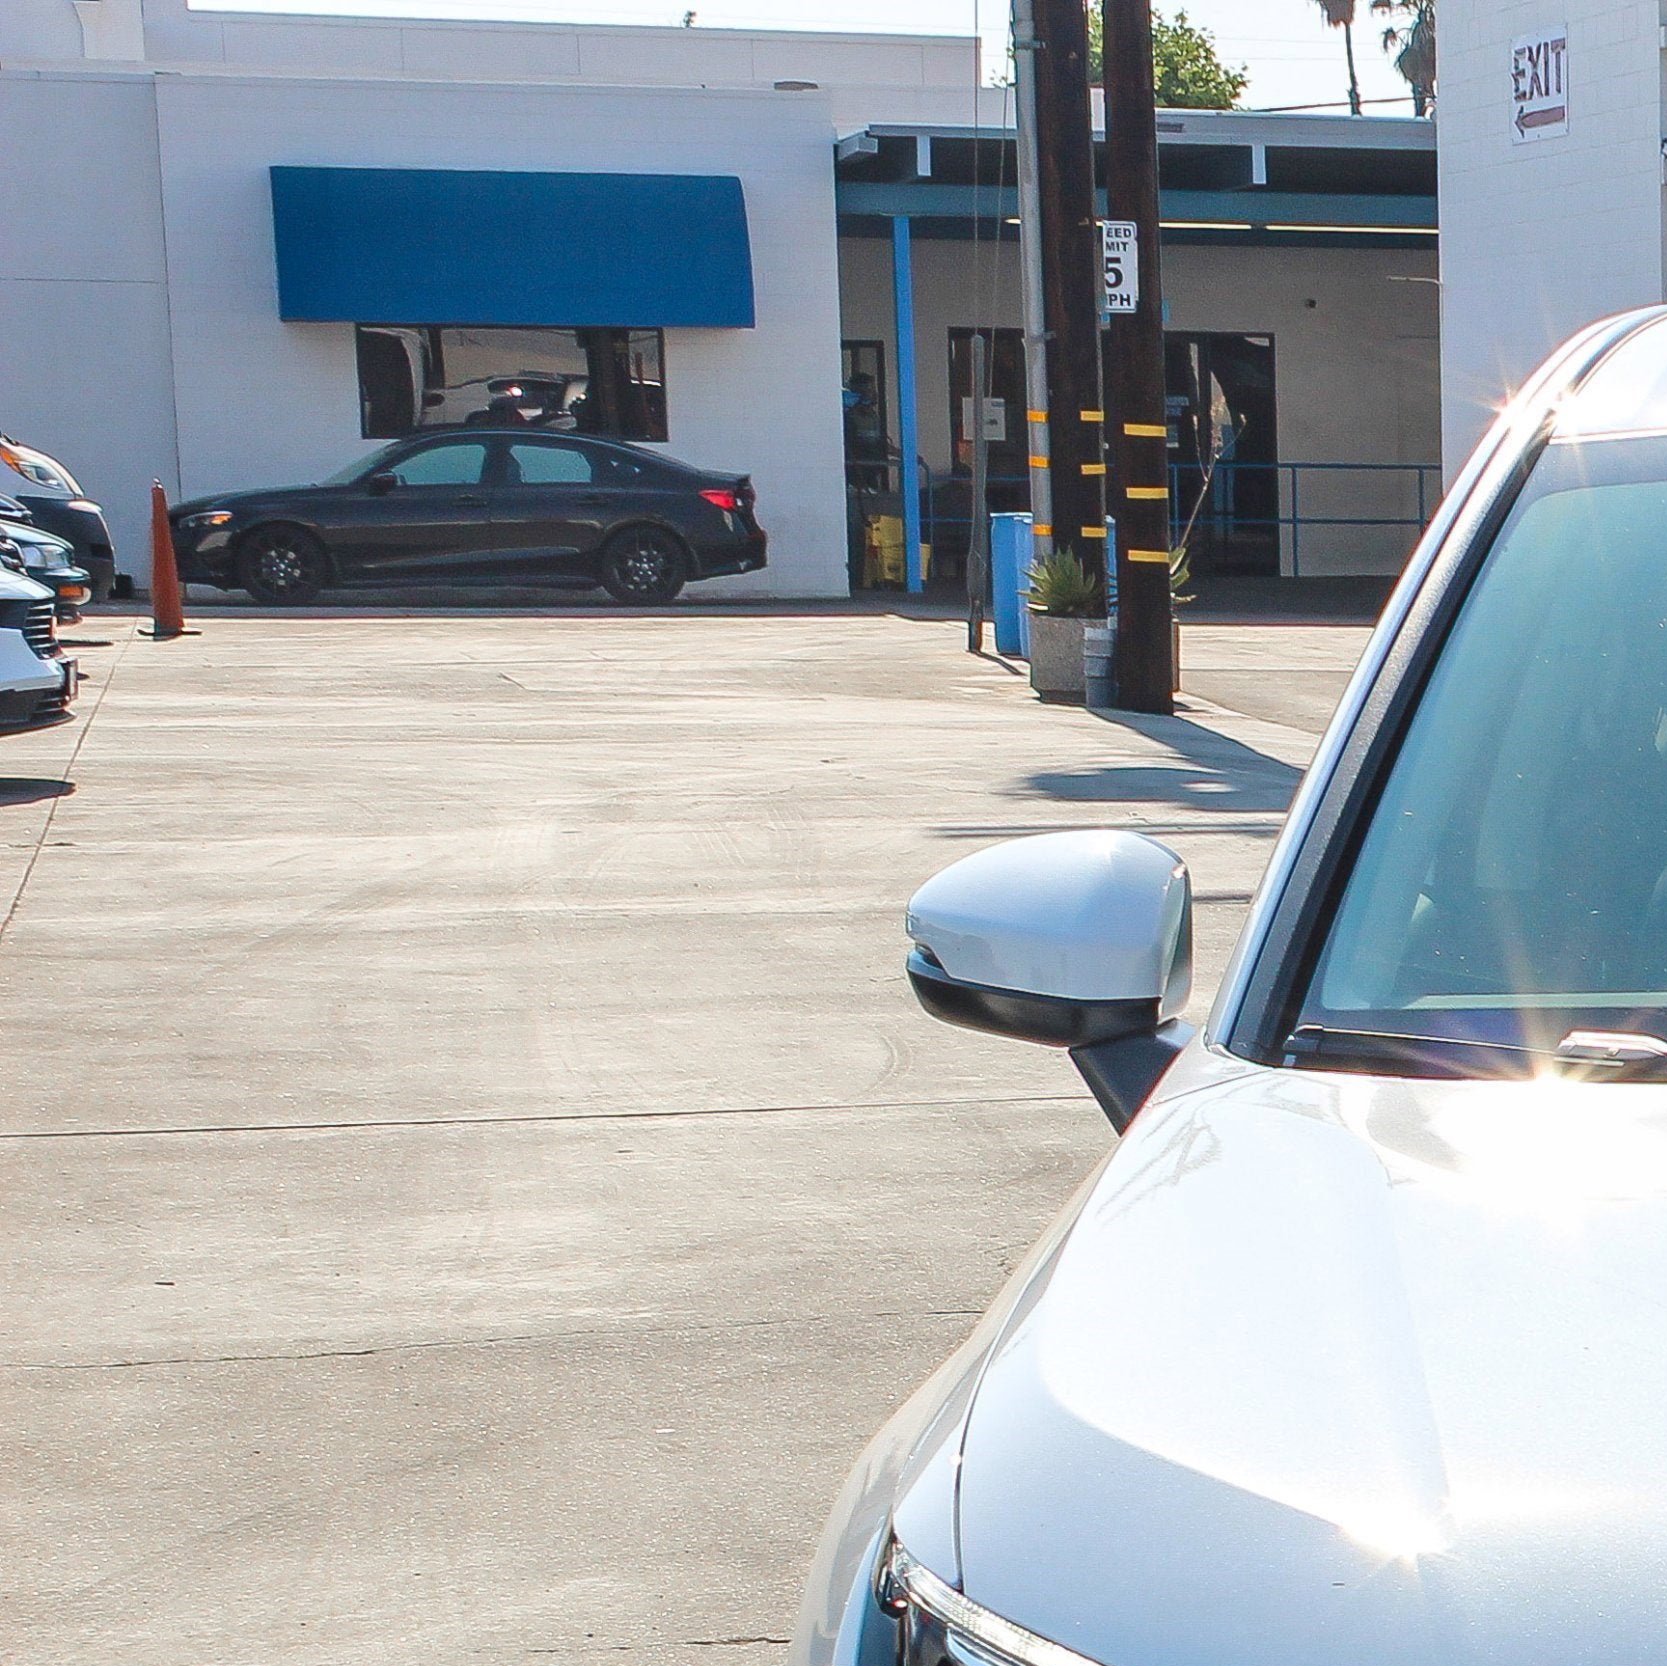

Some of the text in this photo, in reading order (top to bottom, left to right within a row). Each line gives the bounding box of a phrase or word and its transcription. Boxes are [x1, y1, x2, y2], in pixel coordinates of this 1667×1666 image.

[1511, 38, 1565, 102] EXIT
[1106, 227, 1132, 238] EED
[1105, 241, 1129, 252] MIT
[1108, 294, 1131, 306] PH
